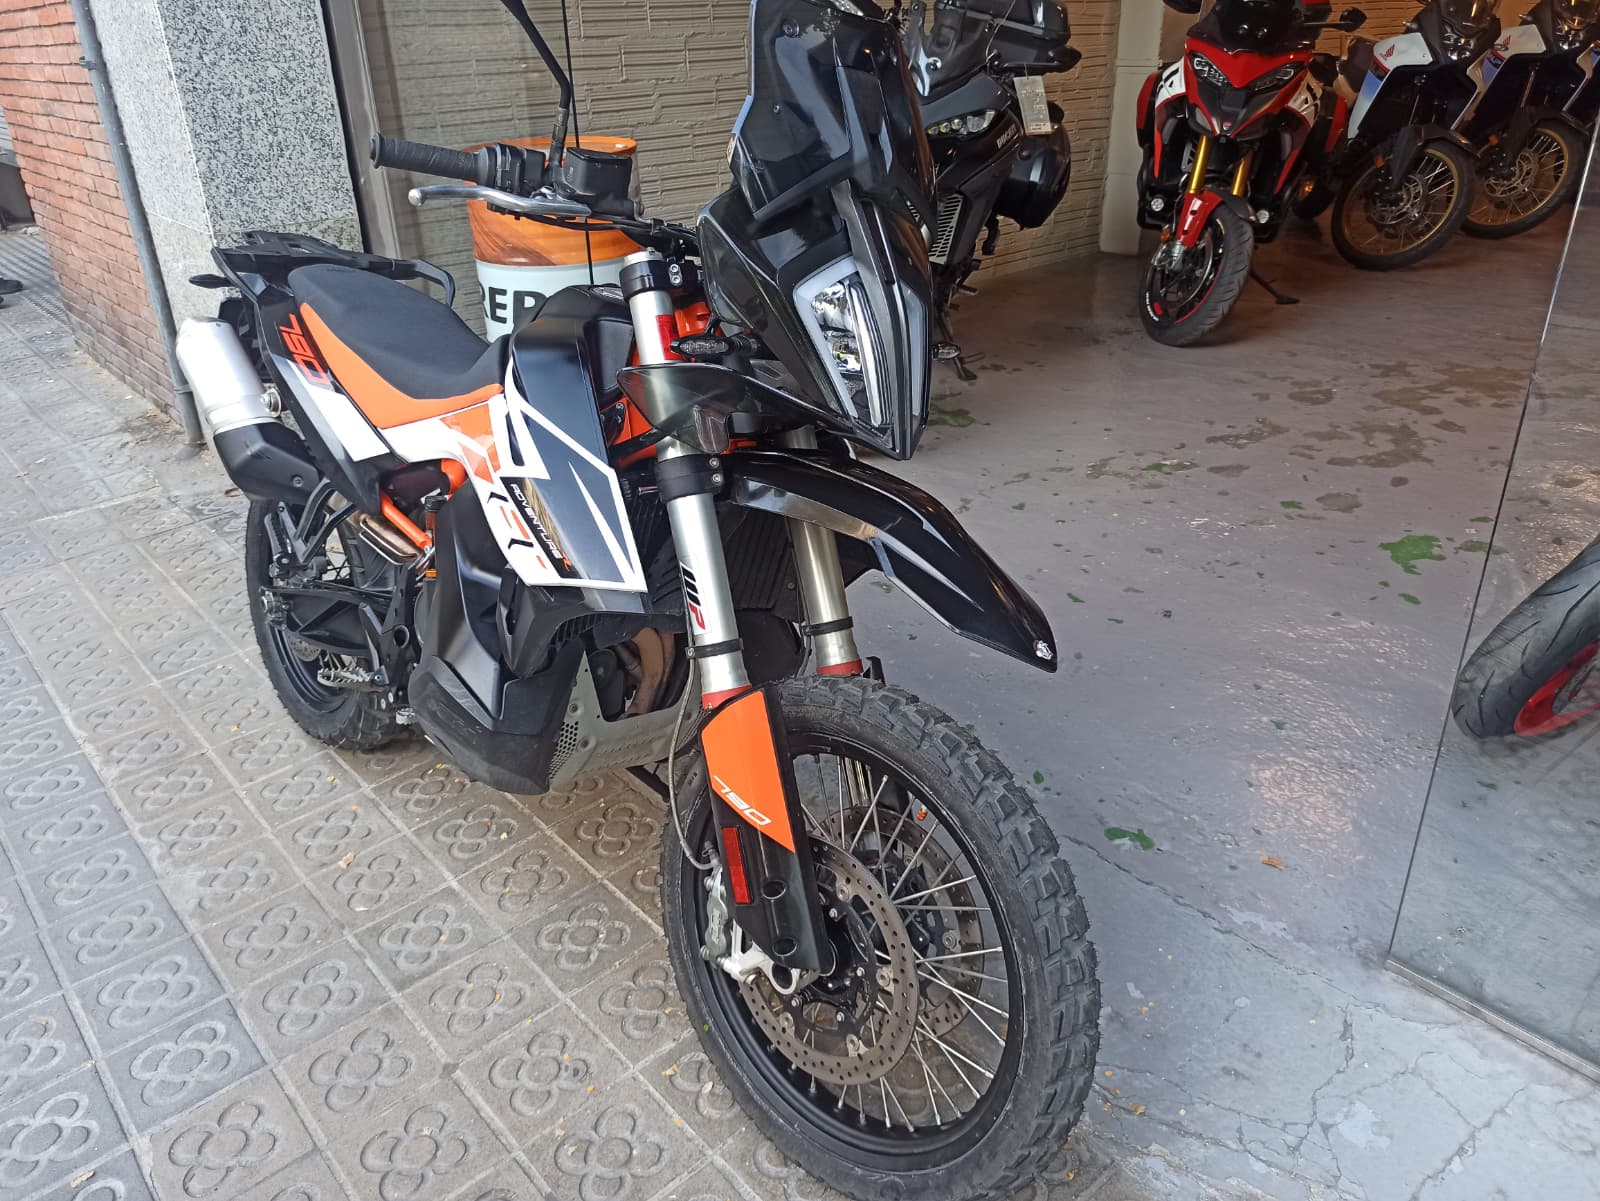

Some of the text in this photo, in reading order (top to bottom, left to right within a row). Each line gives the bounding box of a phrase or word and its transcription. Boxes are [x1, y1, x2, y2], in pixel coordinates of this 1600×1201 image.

[279, 312, 331, 385] 790
[510, 483, 563, 559] ADVENTURE
[713, 775, 772, 826] 790
